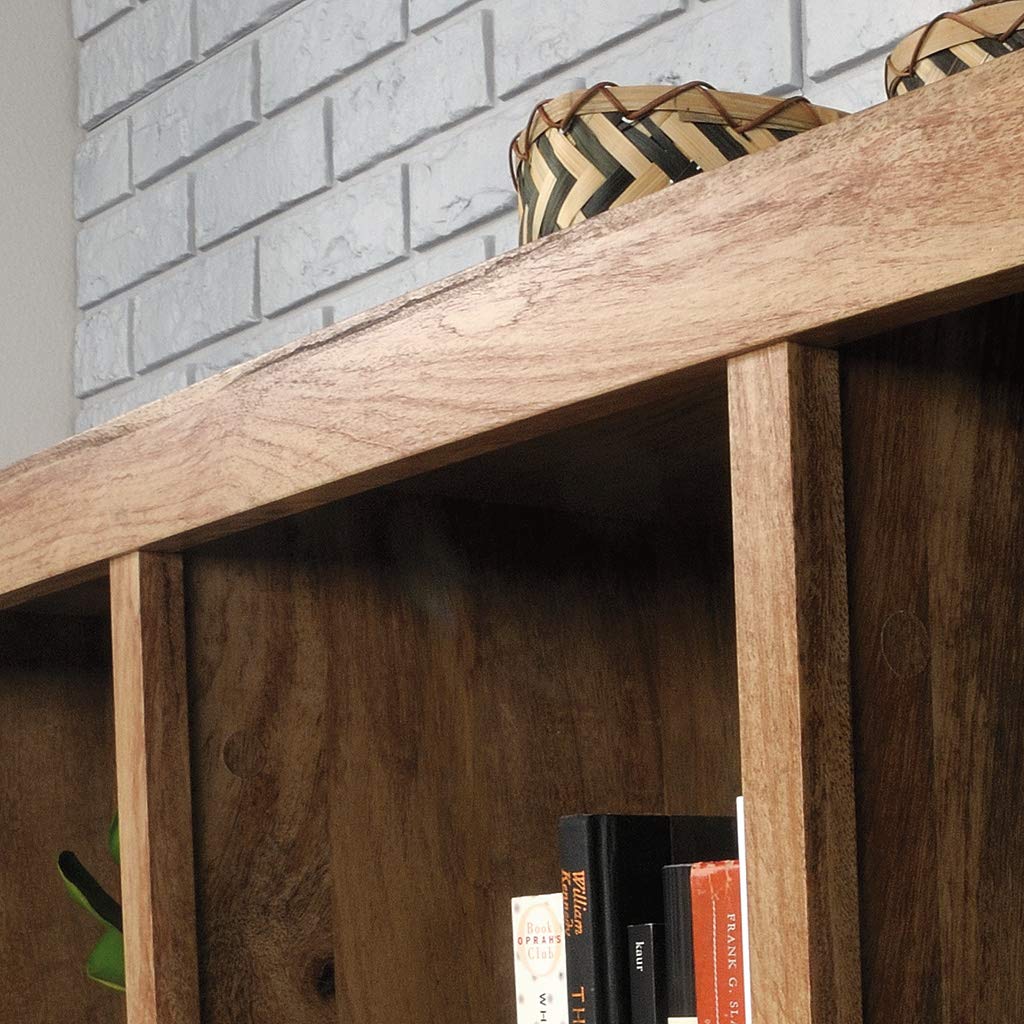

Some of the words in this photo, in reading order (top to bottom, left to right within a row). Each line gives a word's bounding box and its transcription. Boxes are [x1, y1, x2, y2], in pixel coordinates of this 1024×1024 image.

[572, 870, 588, 936] William
[527, 920, 553, 935] Book
[527, 945, 554, 960] Club
[727, 913, 737, 969] FRANK
[635, 941, 645, 972] kaur
[728, 976, 738, 993] G.
